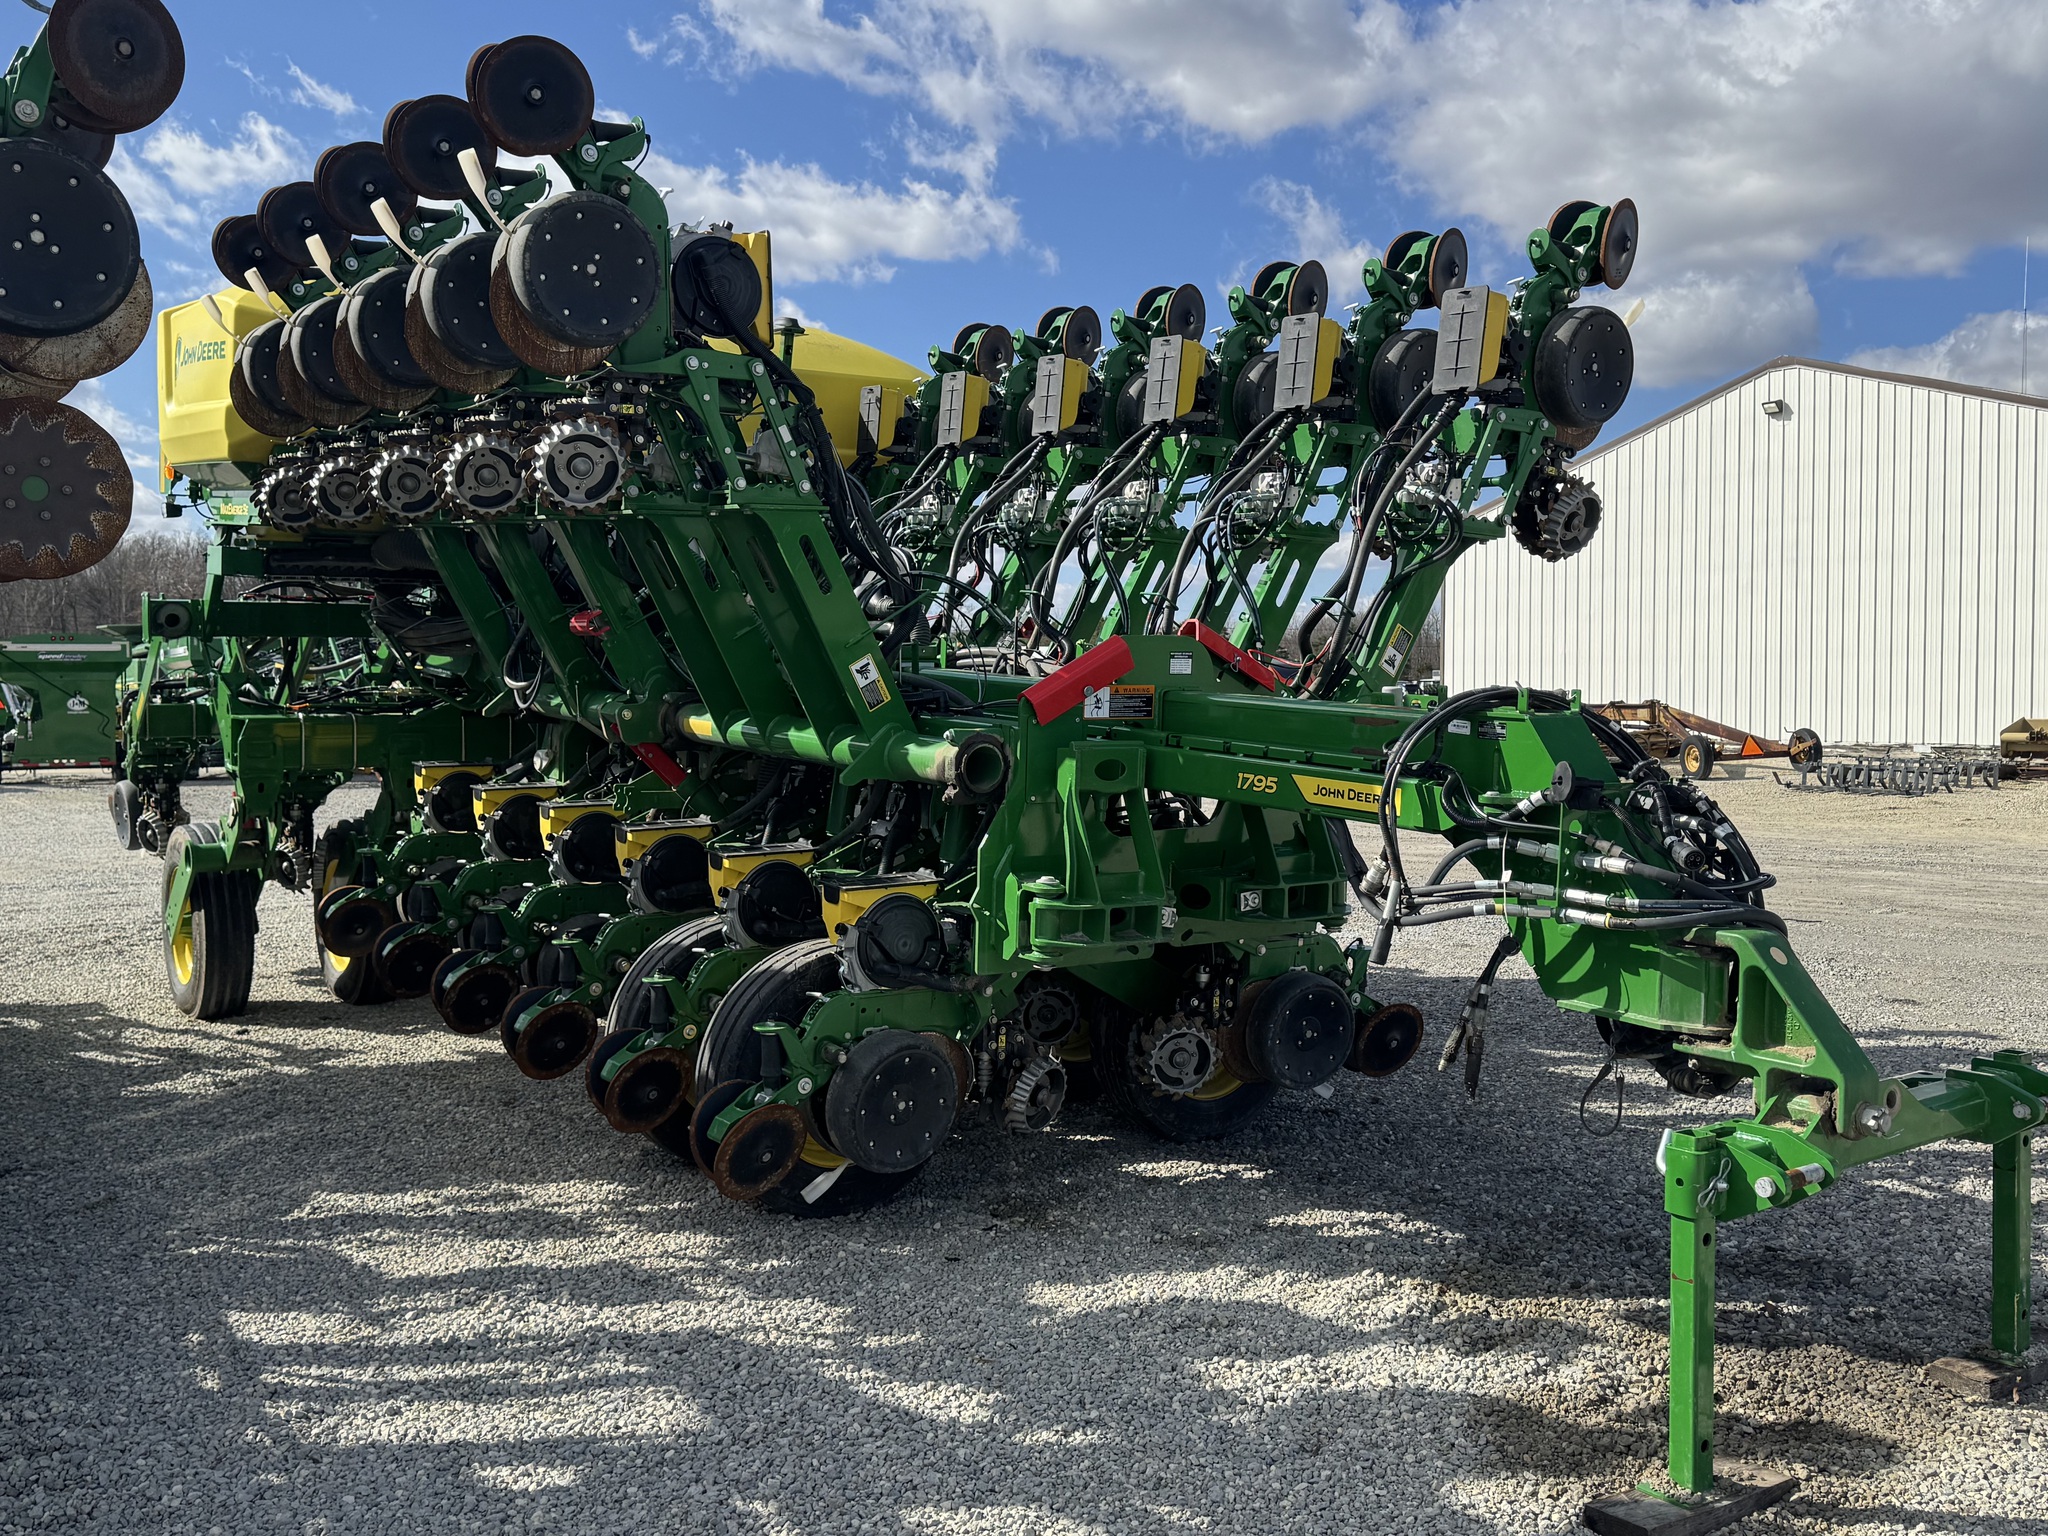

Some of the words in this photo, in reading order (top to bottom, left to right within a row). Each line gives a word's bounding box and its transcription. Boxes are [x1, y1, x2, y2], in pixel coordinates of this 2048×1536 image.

[196, 340, 226, 362] DEERE
[1236, 772, 1278, 793] 1795
[1313, 783, 1345, 800] JOHN
[1347, 788, 1382, 805] DEER
